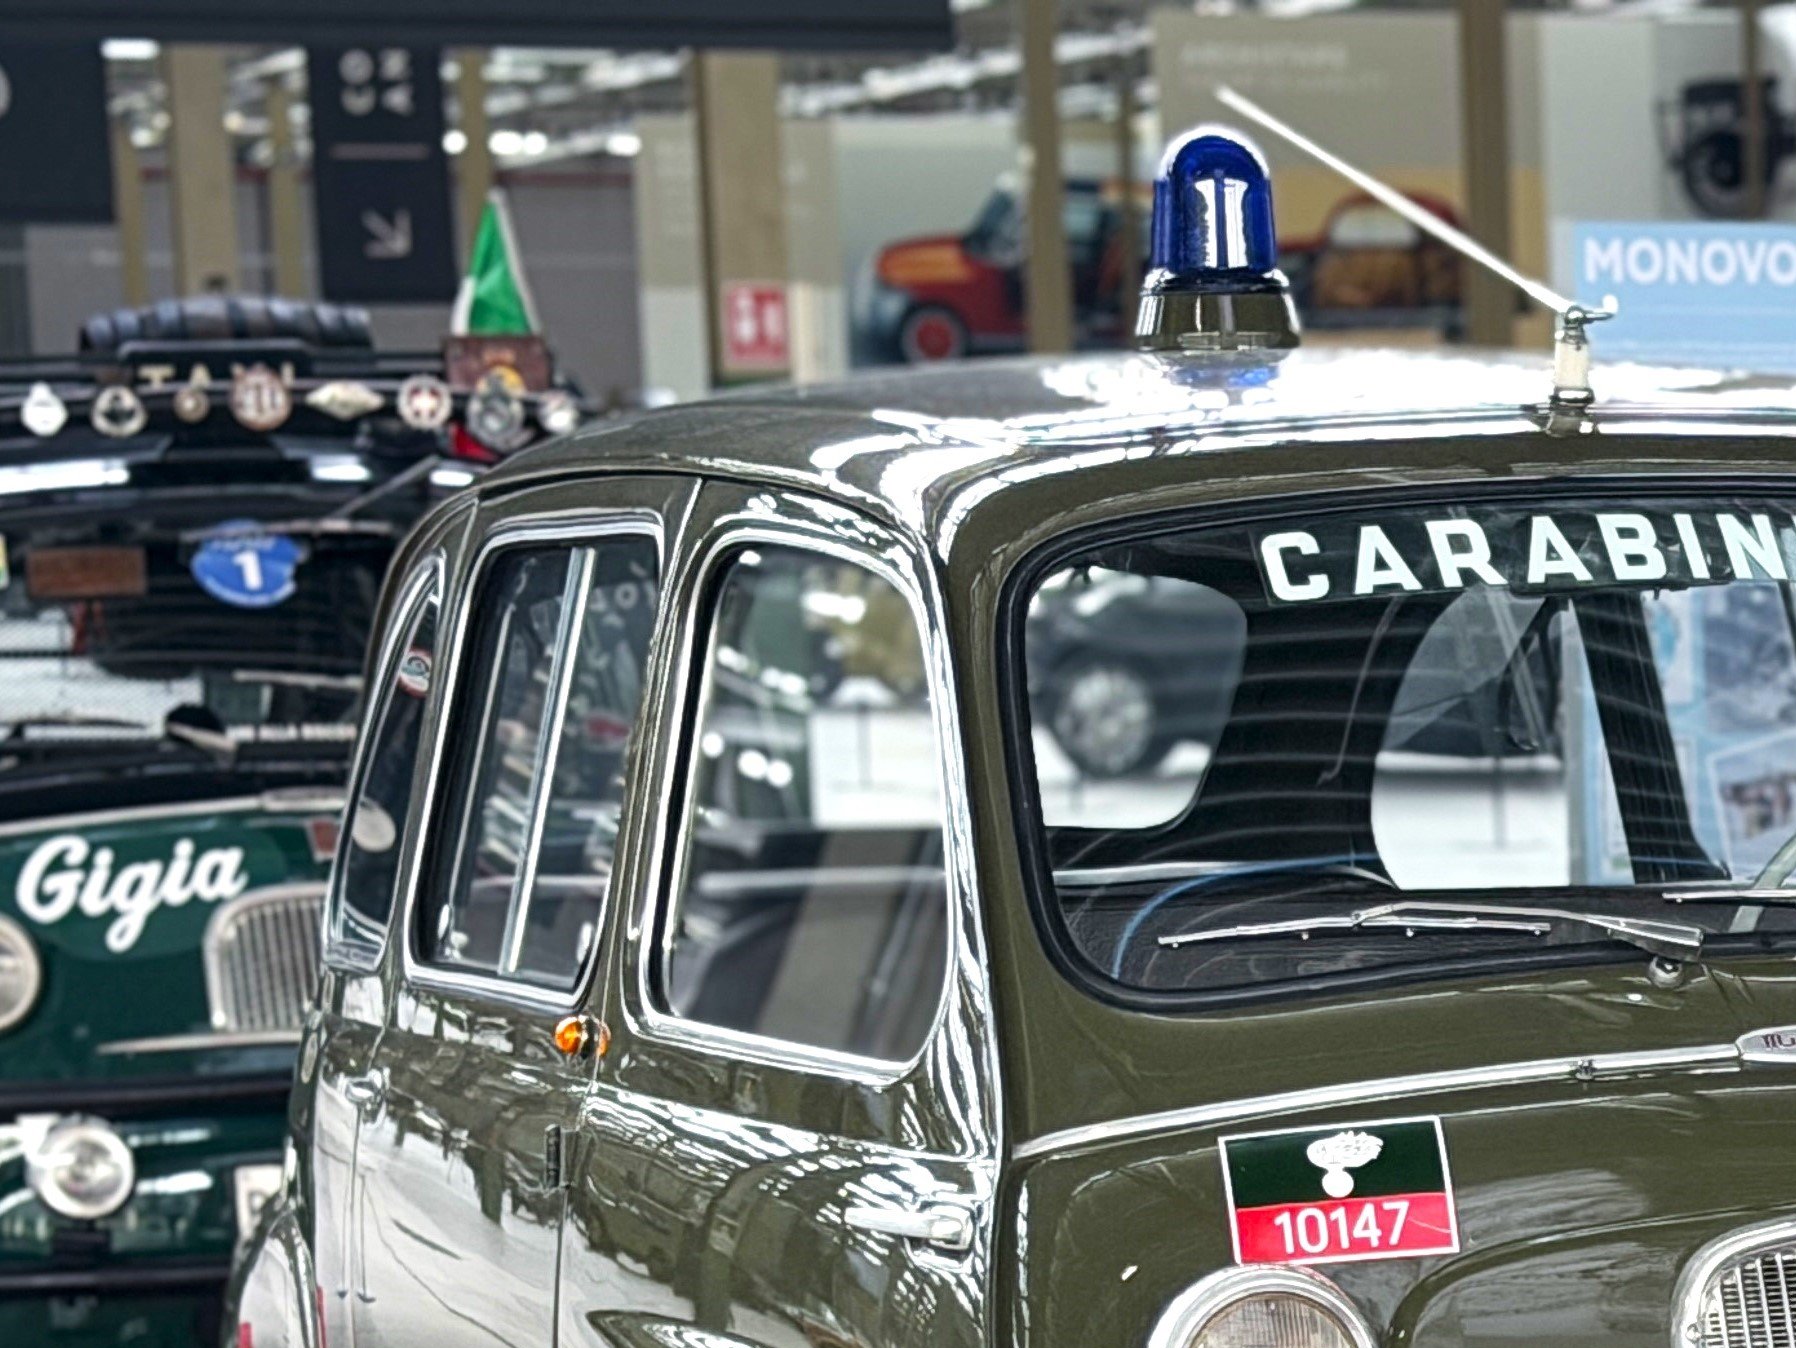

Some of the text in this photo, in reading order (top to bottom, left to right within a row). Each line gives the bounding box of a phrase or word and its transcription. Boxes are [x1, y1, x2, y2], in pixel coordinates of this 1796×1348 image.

[231, 549, 263, 591] 1
[15, 833, 250, 954] Gigia
[1273, 1199, 1410, 1255] 10147
